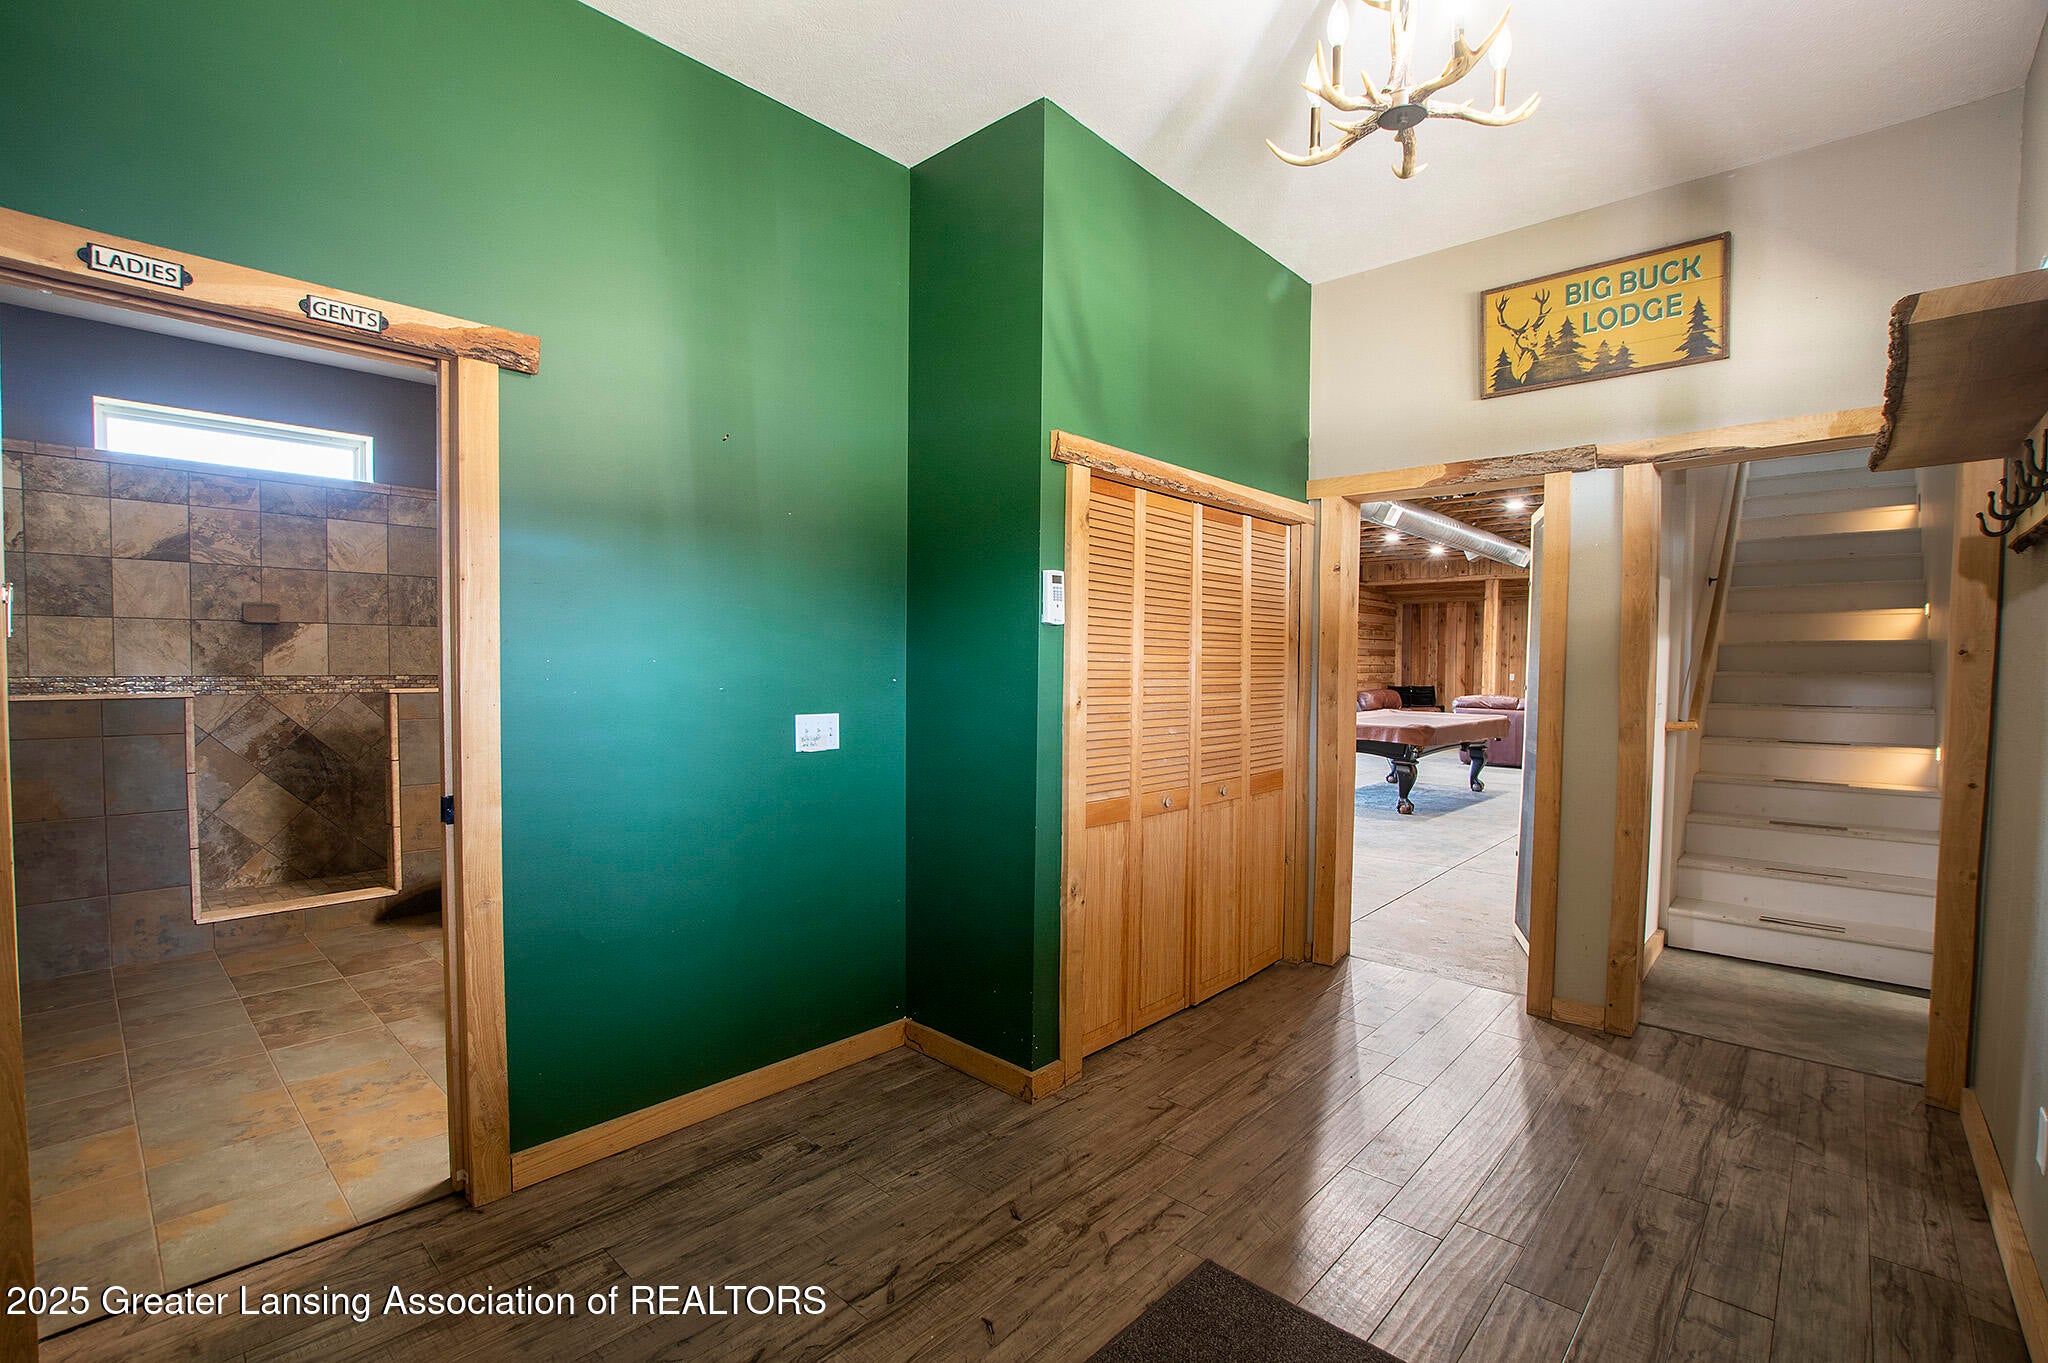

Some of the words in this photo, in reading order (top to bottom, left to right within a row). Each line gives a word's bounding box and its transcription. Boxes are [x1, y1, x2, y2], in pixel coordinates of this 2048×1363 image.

[95, 250, 177, 282] LADIES
[1565, 276, 1612, 307] BIG
[1619, 255, 1702, 295] BUCK
[312, 300, 378, 328] GENTS
[1583, 292, 1683, 335] LODGE
